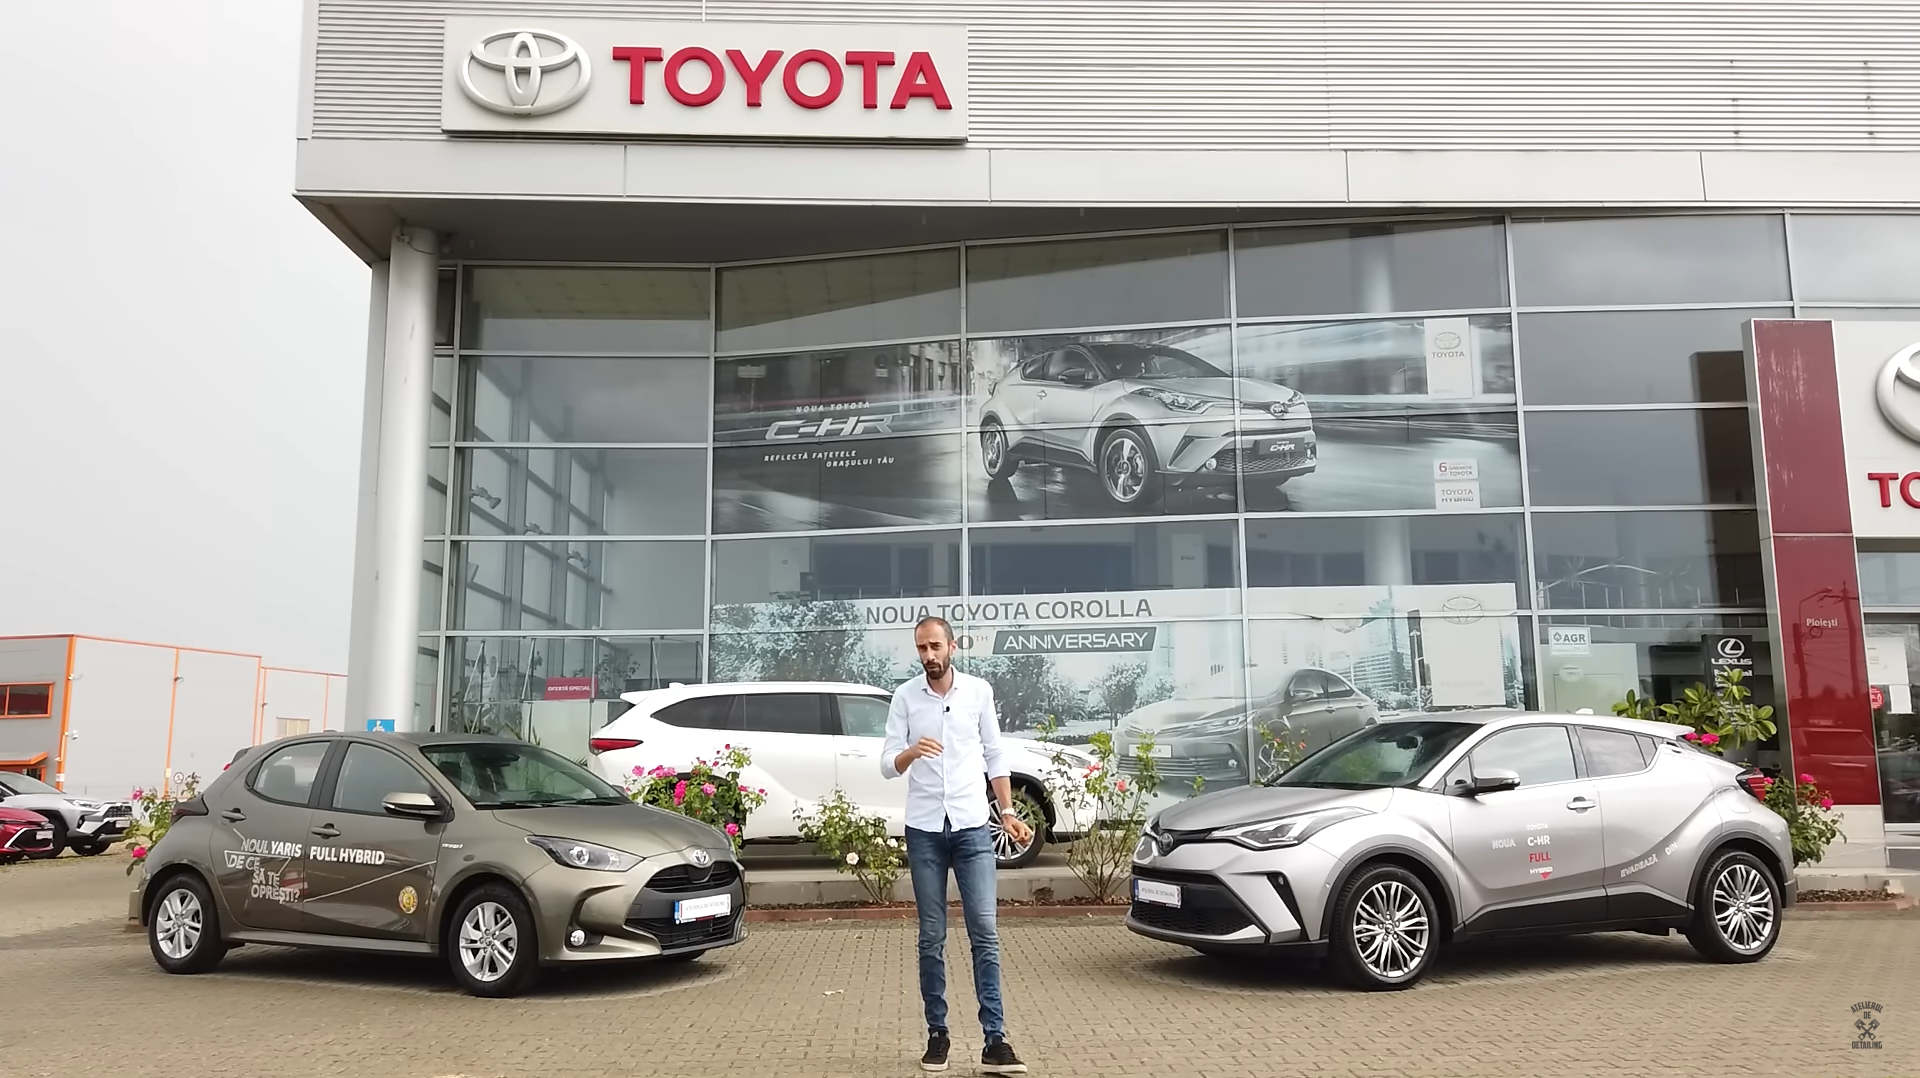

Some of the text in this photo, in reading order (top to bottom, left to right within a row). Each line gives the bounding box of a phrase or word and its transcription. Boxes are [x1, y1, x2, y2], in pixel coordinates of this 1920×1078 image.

[612, 46, 953, 110] TOYOTA
[1431, 350, 1465, 359] TOYOTA
[796, 401, 870, 414] NOUA TOYOTA
[765, 416, 893, 440] C-HR
[1438, 462, 1448, 473] 6
[1441, 488, 1474, 496] TOYOTA
[866, 599, 1152, 625] NOUA TOYOTA COROLLA
[1003, 632, 1149, 651] ANNIVERSARY
[1563, 633, 1586, 643] AGR
[1491, 838, 1516, 850] NOUA
[1527, 835, 1551, 847] C-HR
[241, 838, 386, 866] NOUL YARIS FULL HYBRID
[1664, 841, 1678, 856] DIN
[227, 854, 245, 869] DE
[1529, 851, 1552, 863] FULL
